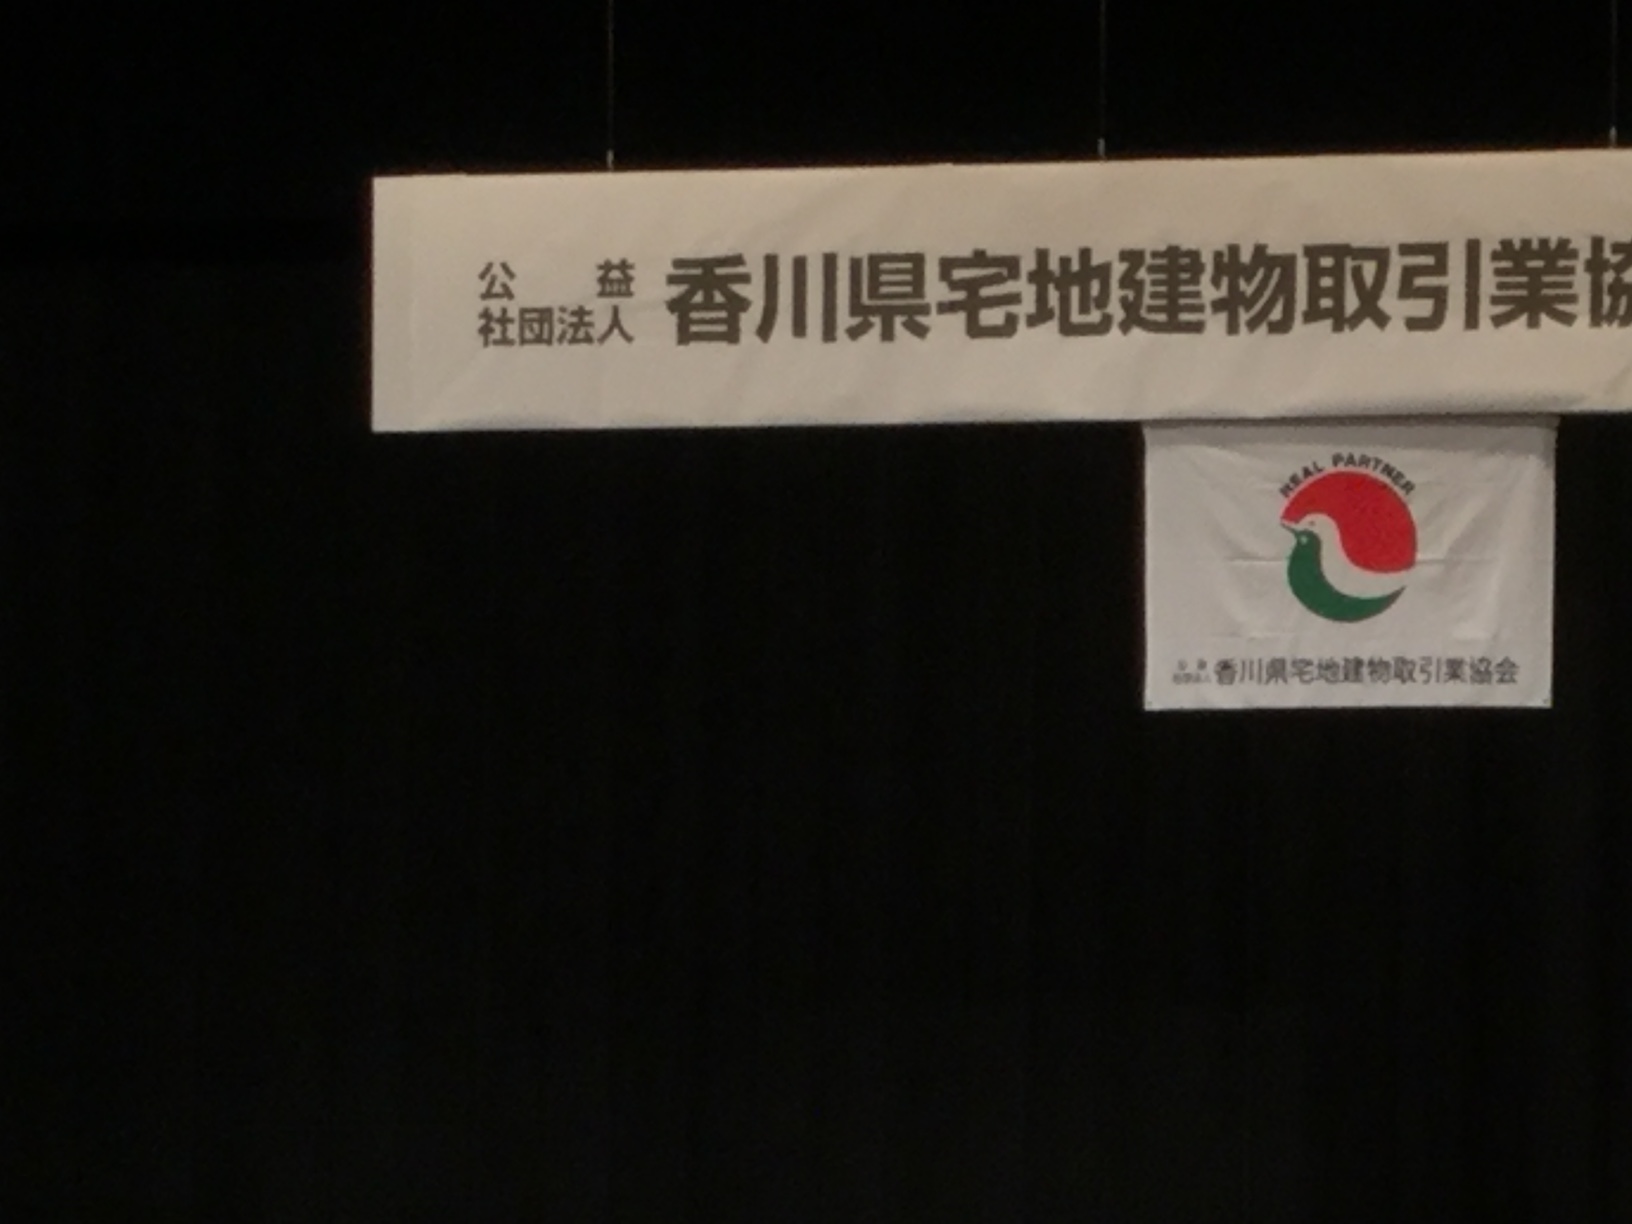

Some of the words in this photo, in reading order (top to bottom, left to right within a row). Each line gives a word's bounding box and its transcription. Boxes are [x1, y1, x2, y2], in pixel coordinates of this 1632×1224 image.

[476, 304, 636, 348] 社団法人
[1278, 461, 1326, 499] REAL
[1332, 452, 1417, 497] PARTNER
[1213, 655, 1520, 686] 香川県宅地建物取引業協会
